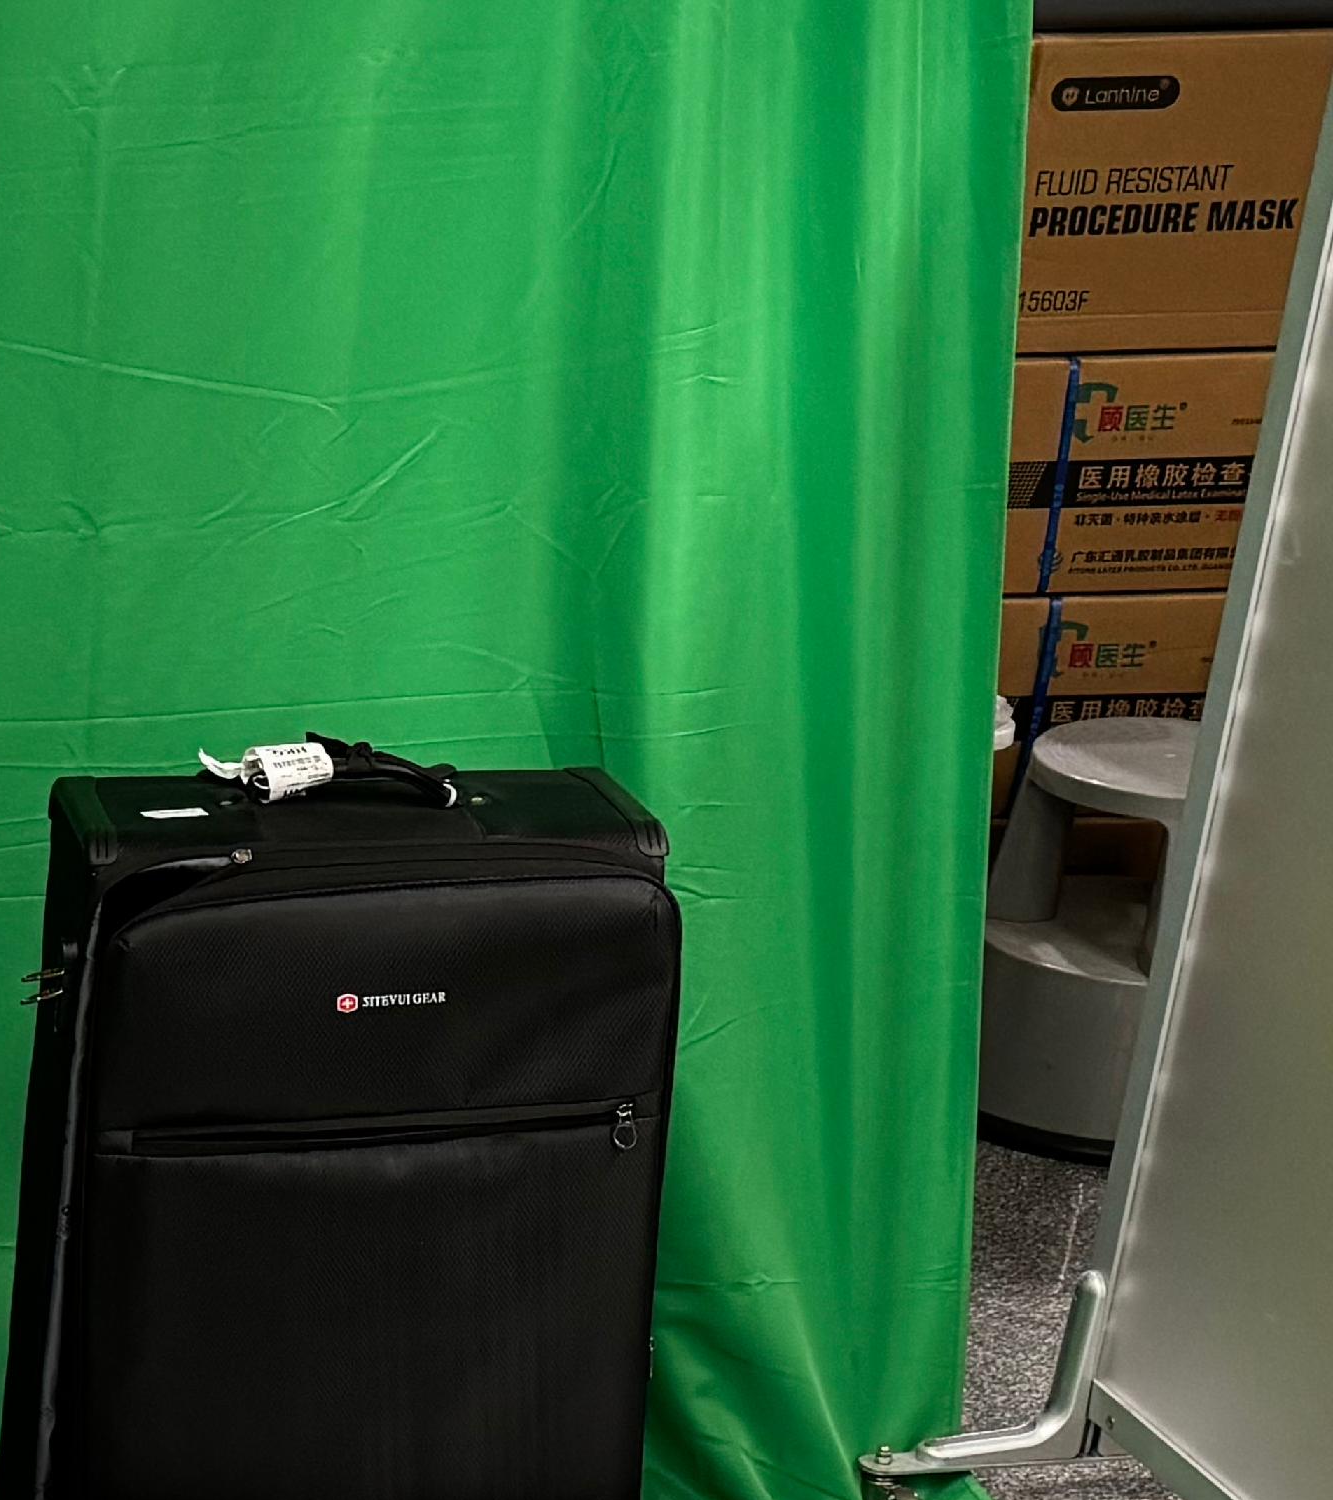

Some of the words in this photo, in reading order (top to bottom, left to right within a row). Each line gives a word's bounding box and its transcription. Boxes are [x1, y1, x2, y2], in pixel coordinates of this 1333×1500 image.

[1034, 169, 1098, 196] FLUID
[1105, 164, 1234, 194] RESISTANT
[1028, 202, 1199, 238] PROCEDURE
[1206, 198, 1299, 232] MASK
[1098, 404, 1176, 432] 顾医生
[1078, 462, 1246, 489] 医用橡胶检查
[1068, 643, 1145, 668] 顾医生
[412, 992, 446, 1005] GEAR
